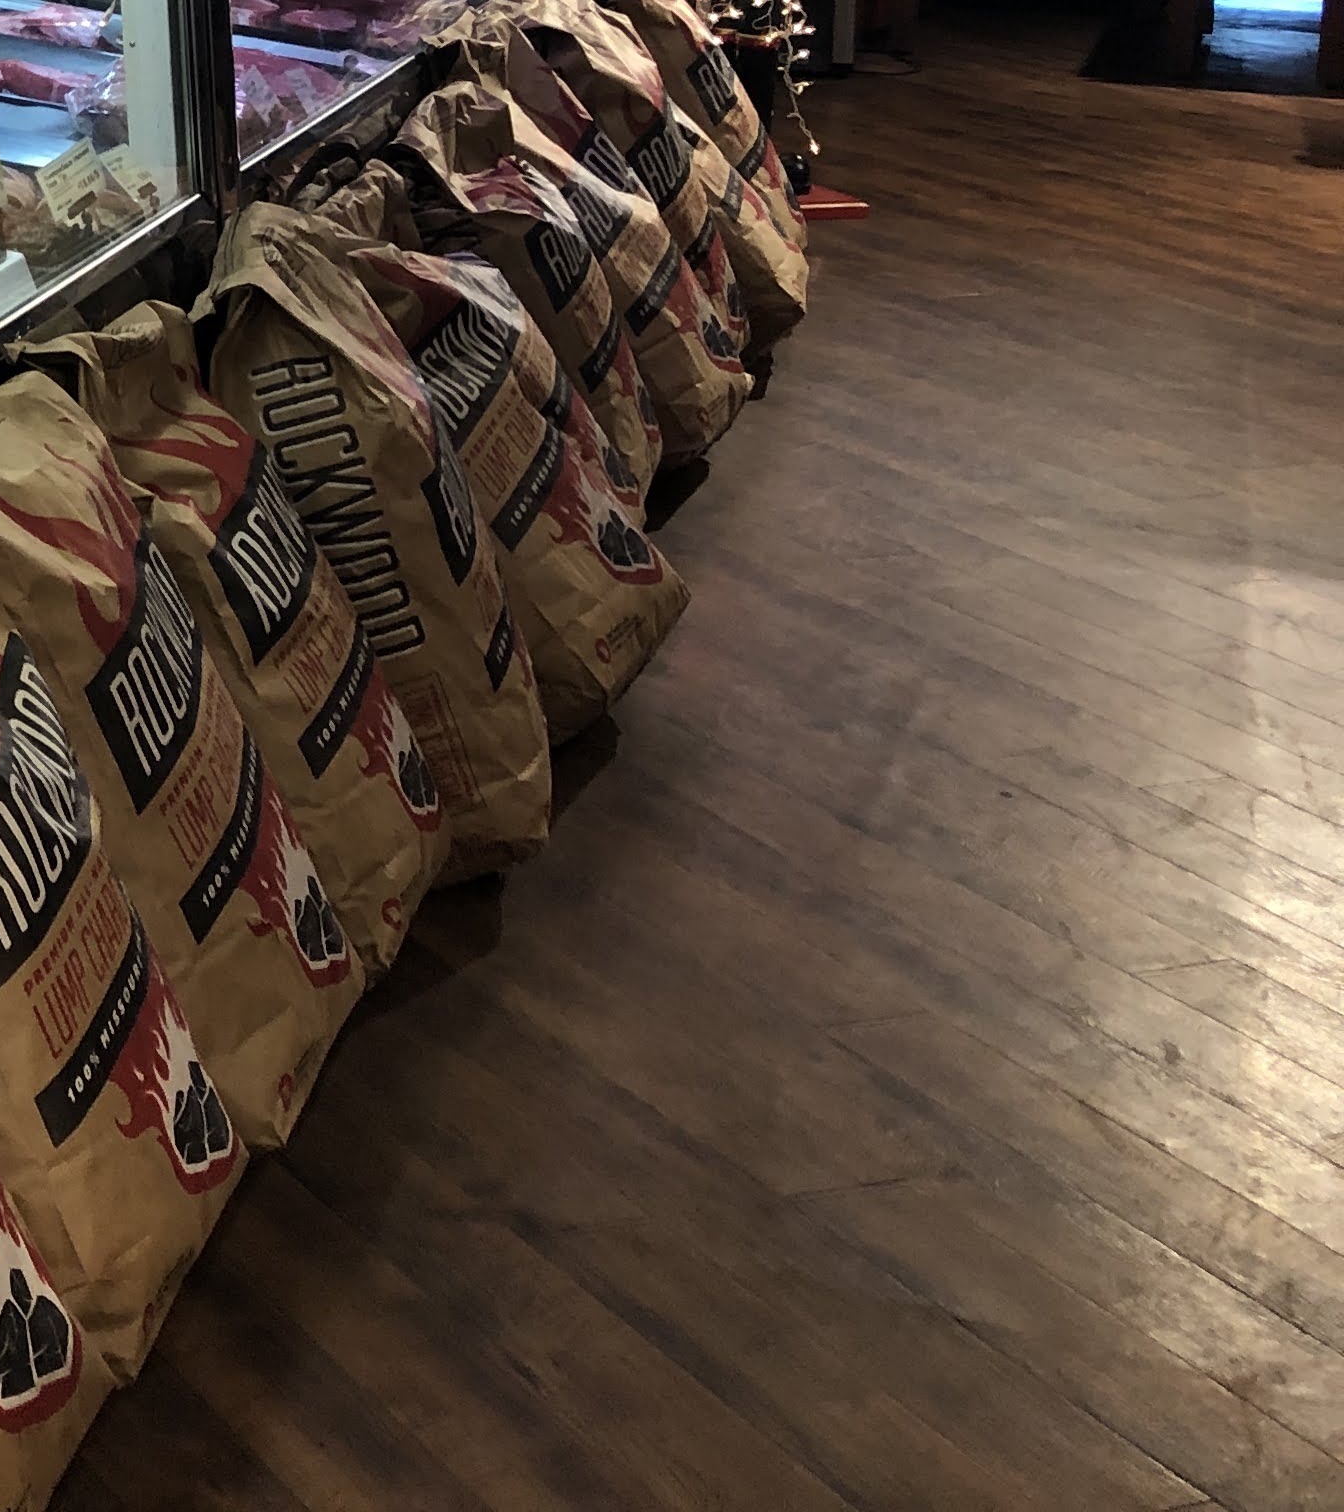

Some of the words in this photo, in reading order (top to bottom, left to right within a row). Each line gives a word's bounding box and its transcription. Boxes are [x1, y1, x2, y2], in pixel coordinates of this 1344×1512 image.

[249, 354, 426, 661] ROCKWOOD
[168, 774, 220, 872] LUMP
[32, 947, 90, 1061] LUMP
[67, 1050, 100, 1103] 100%
[100, 955, 143, 1050] MISSOURI
